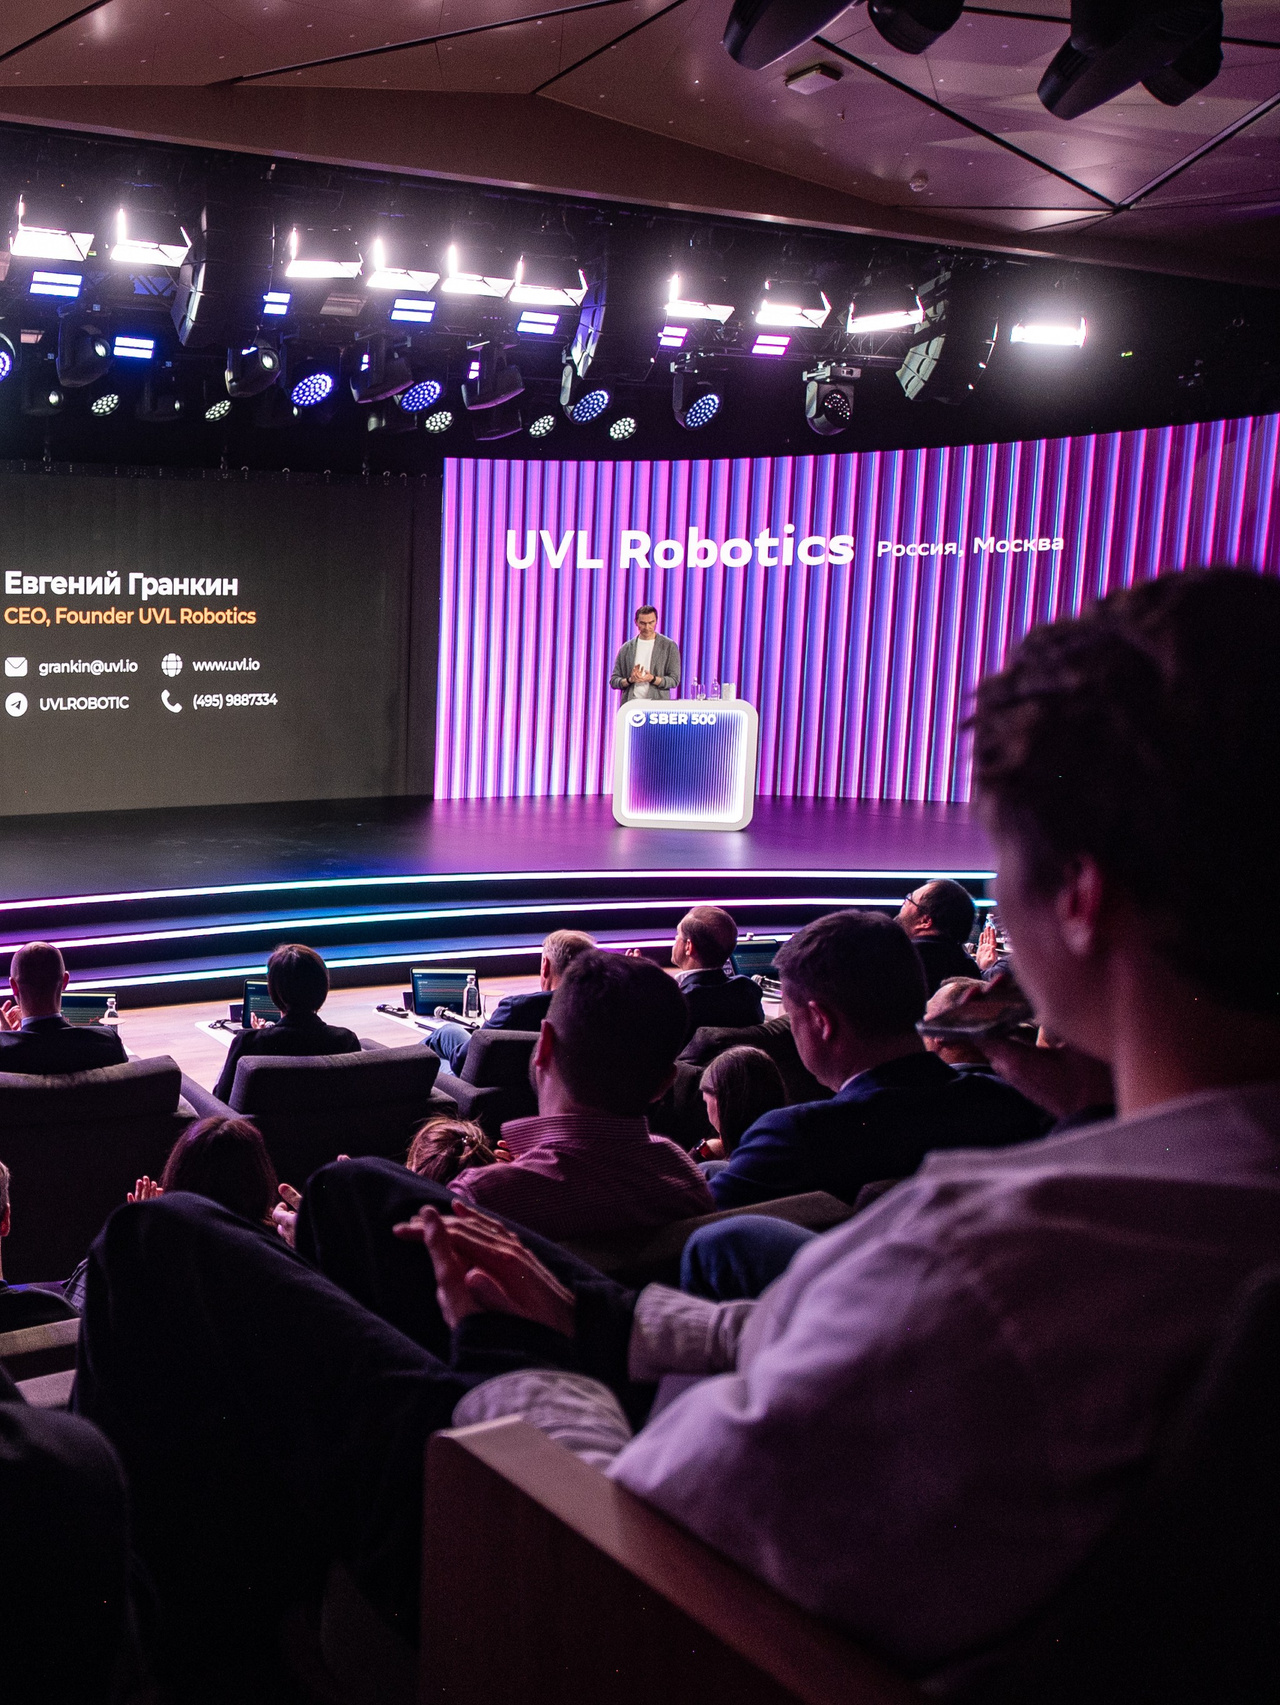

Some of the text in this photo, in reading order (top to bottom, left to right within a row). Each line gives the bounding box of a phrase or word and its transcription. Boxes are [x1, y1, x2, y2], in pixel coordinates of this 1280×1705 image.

[506, 523, 856, 570] UVL Robotics
[877, 536, 1065, 558] Россия, Москва
[4, 570, 238, 601] Евгений Гранкин
[4, 607, 256, 627] CEO, Founder UVL Robotics
[38, 659, 138, 677] grankin@uvl.io
[192, 657, 261, 672] www.uvl.io
[39, 696, 129, 711] UVLROBOTIC
[192, 693, 278, 710] (495) 9887334
[649, 713, 717, 725] SBER 500
